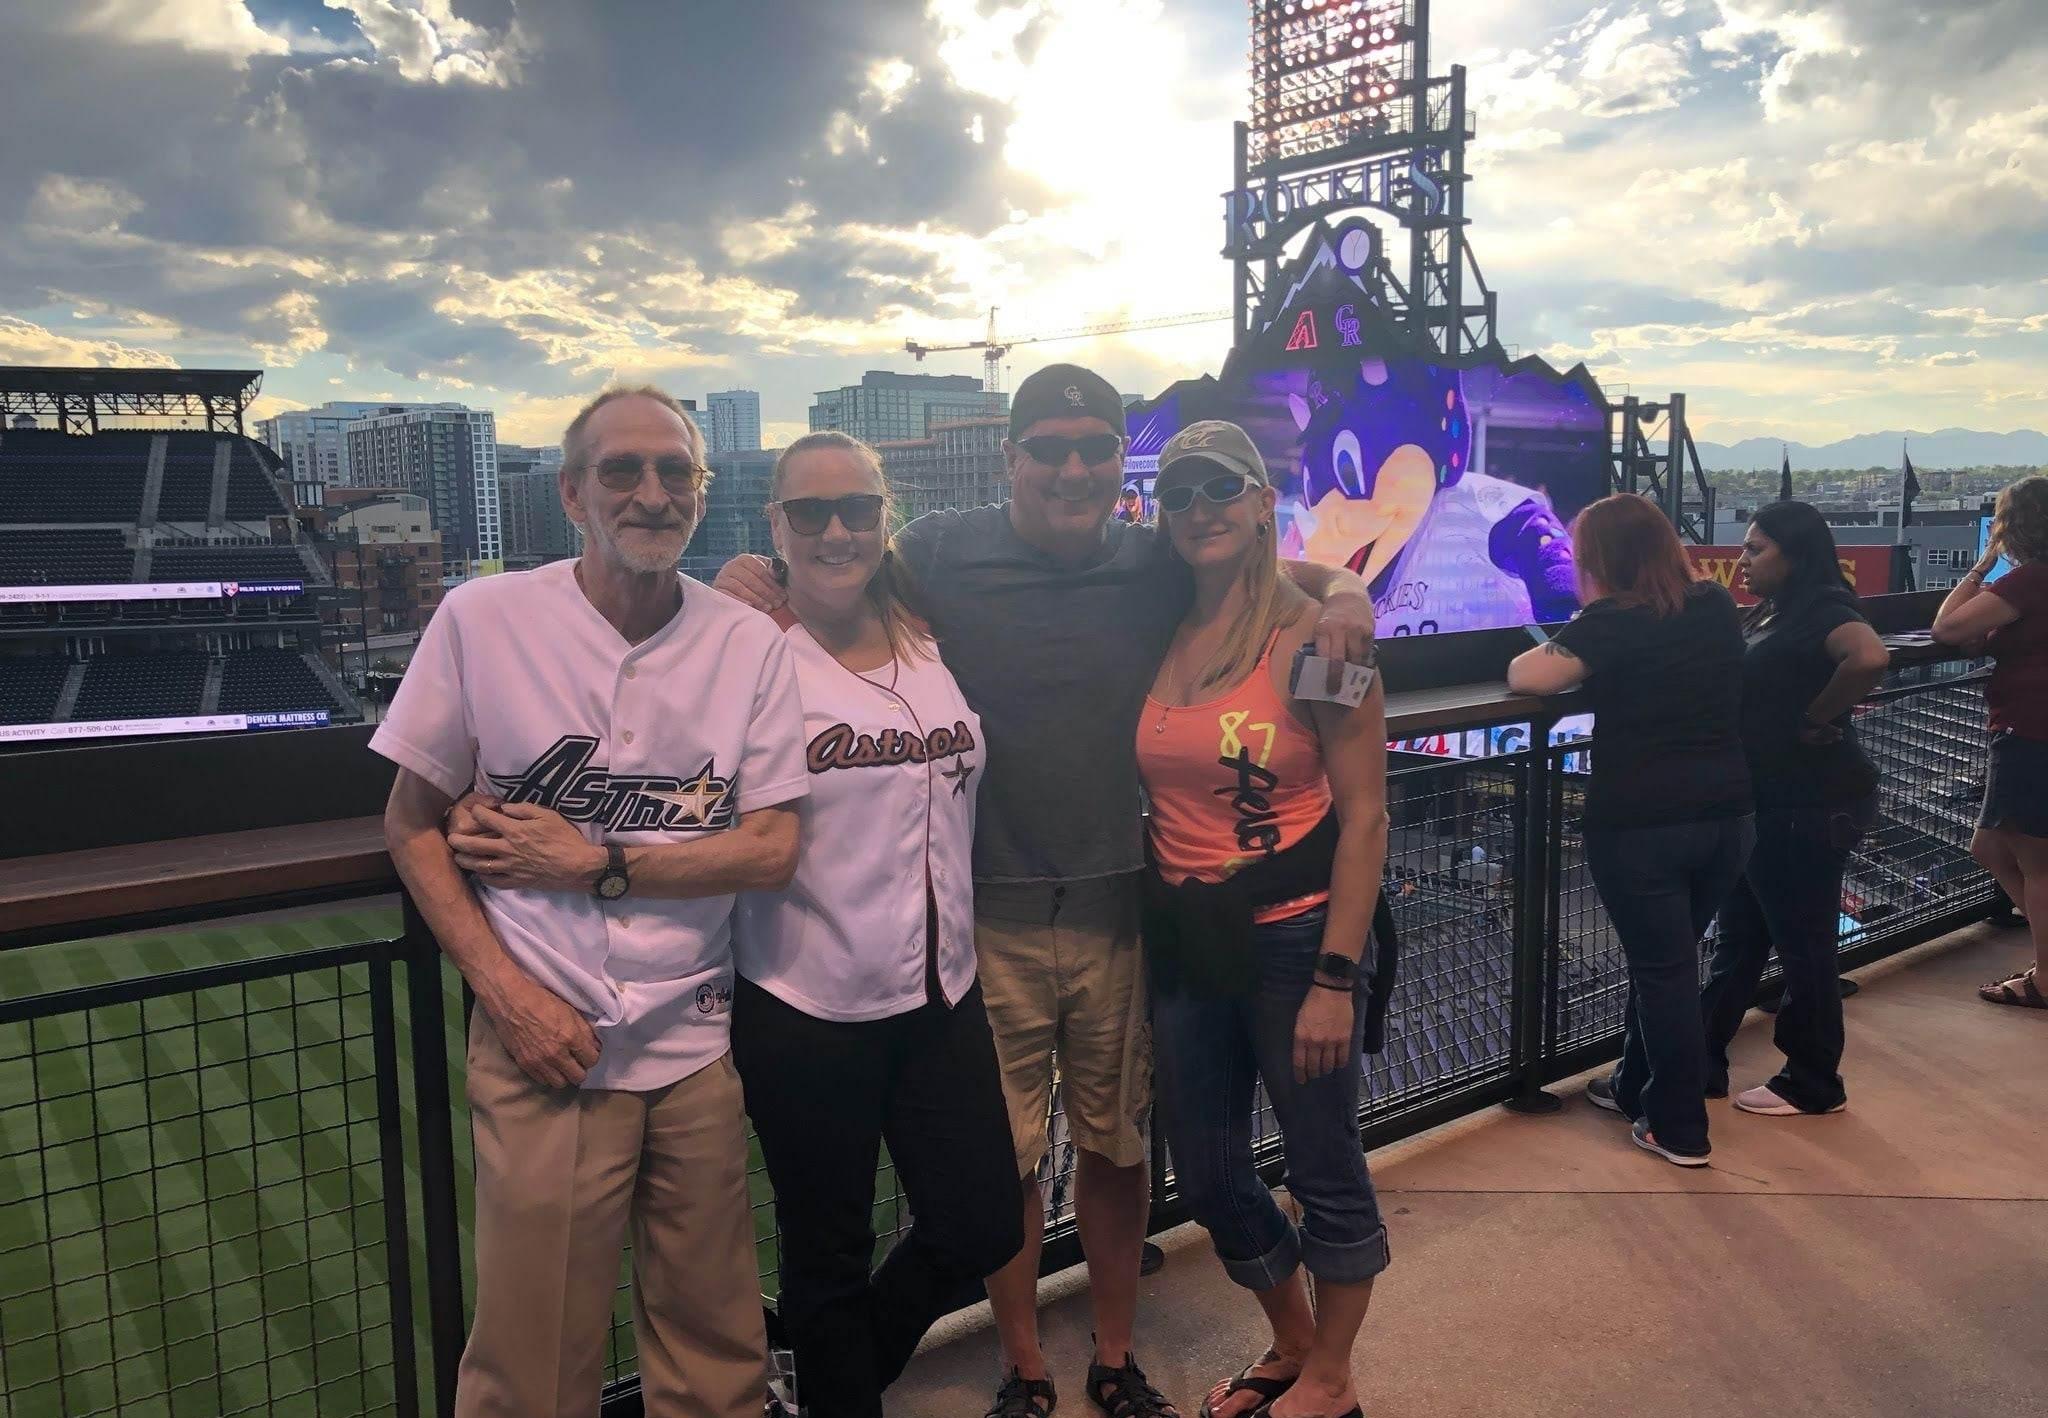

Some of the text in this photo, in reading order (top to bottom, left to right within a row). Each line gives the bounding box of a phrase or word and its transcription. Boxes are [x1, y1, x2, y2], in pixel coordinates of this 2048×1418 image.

[1220, 149, 1444, 255] ROCKIES
[12, 728, 46, 737] ACTIVITY
[247, 715, 278, 724] DENVER
[279, 712, 315, 723] MATTRESS
[1219, 710, 1277, 768] 87
[805, 720, 975, 775] Astros
